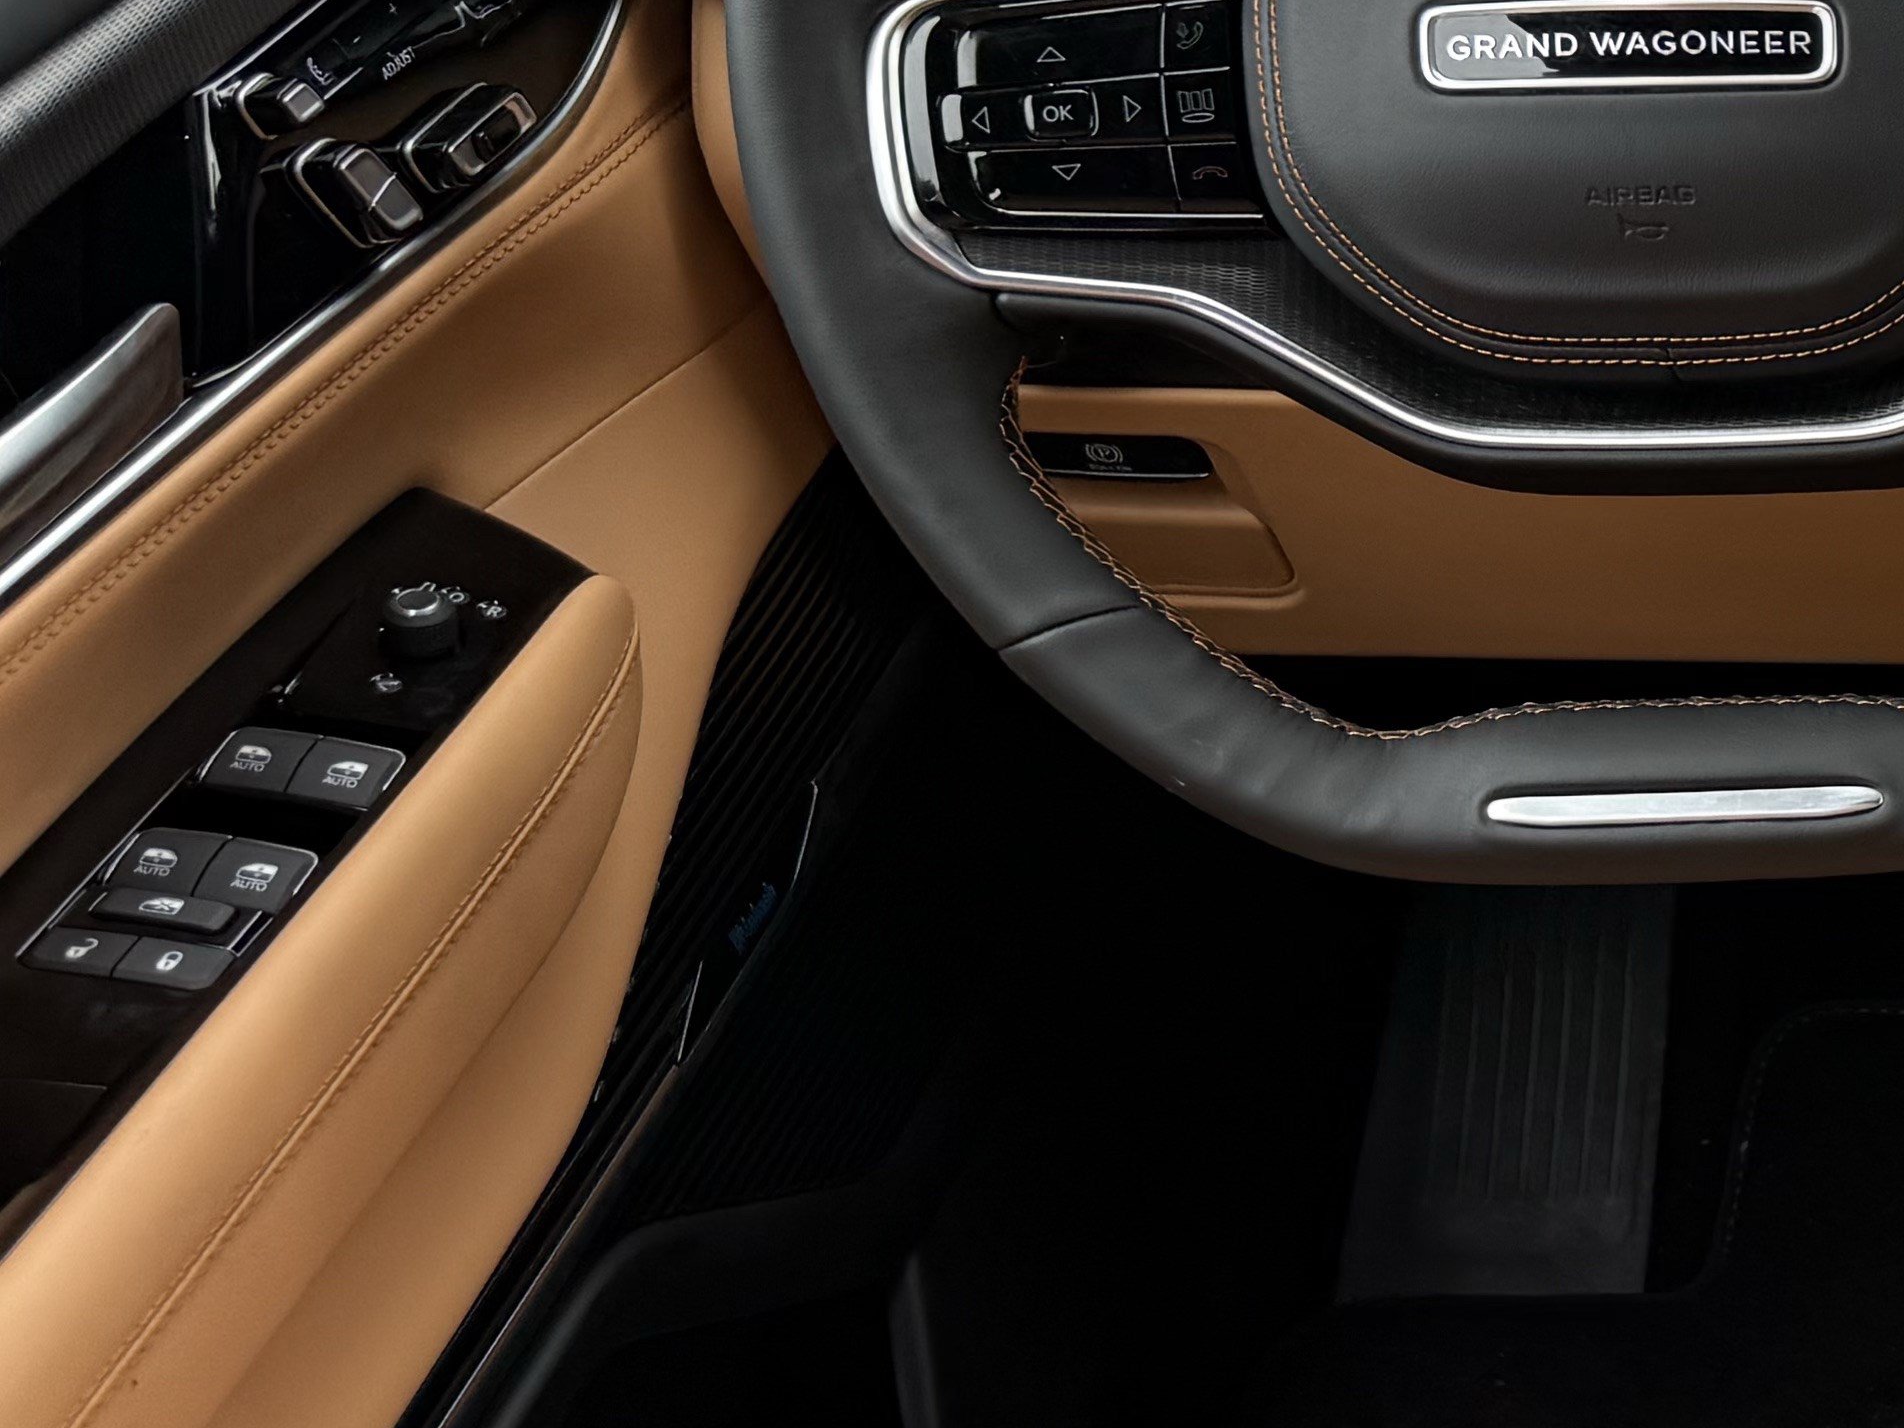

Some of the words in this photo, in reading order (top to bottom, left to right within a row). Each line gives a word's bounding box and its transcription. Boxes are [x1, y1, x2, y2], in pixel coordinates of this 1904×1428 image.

[1445, 31, 1579, 62] GRAND
[1588, 28, 1813, 57] WAGONEER
[381, 45, 418, 82] ADJUST
[1041, 103, 1074, 123] OK
[1584, 184, 1697, 208] AIRBAG
[229, 760, 265, 773] AUTO
[321, 775, 358, 789] AUTO
[133, 865, 170, 878] AUTO
[230, 878, 268, 892] AUTO
